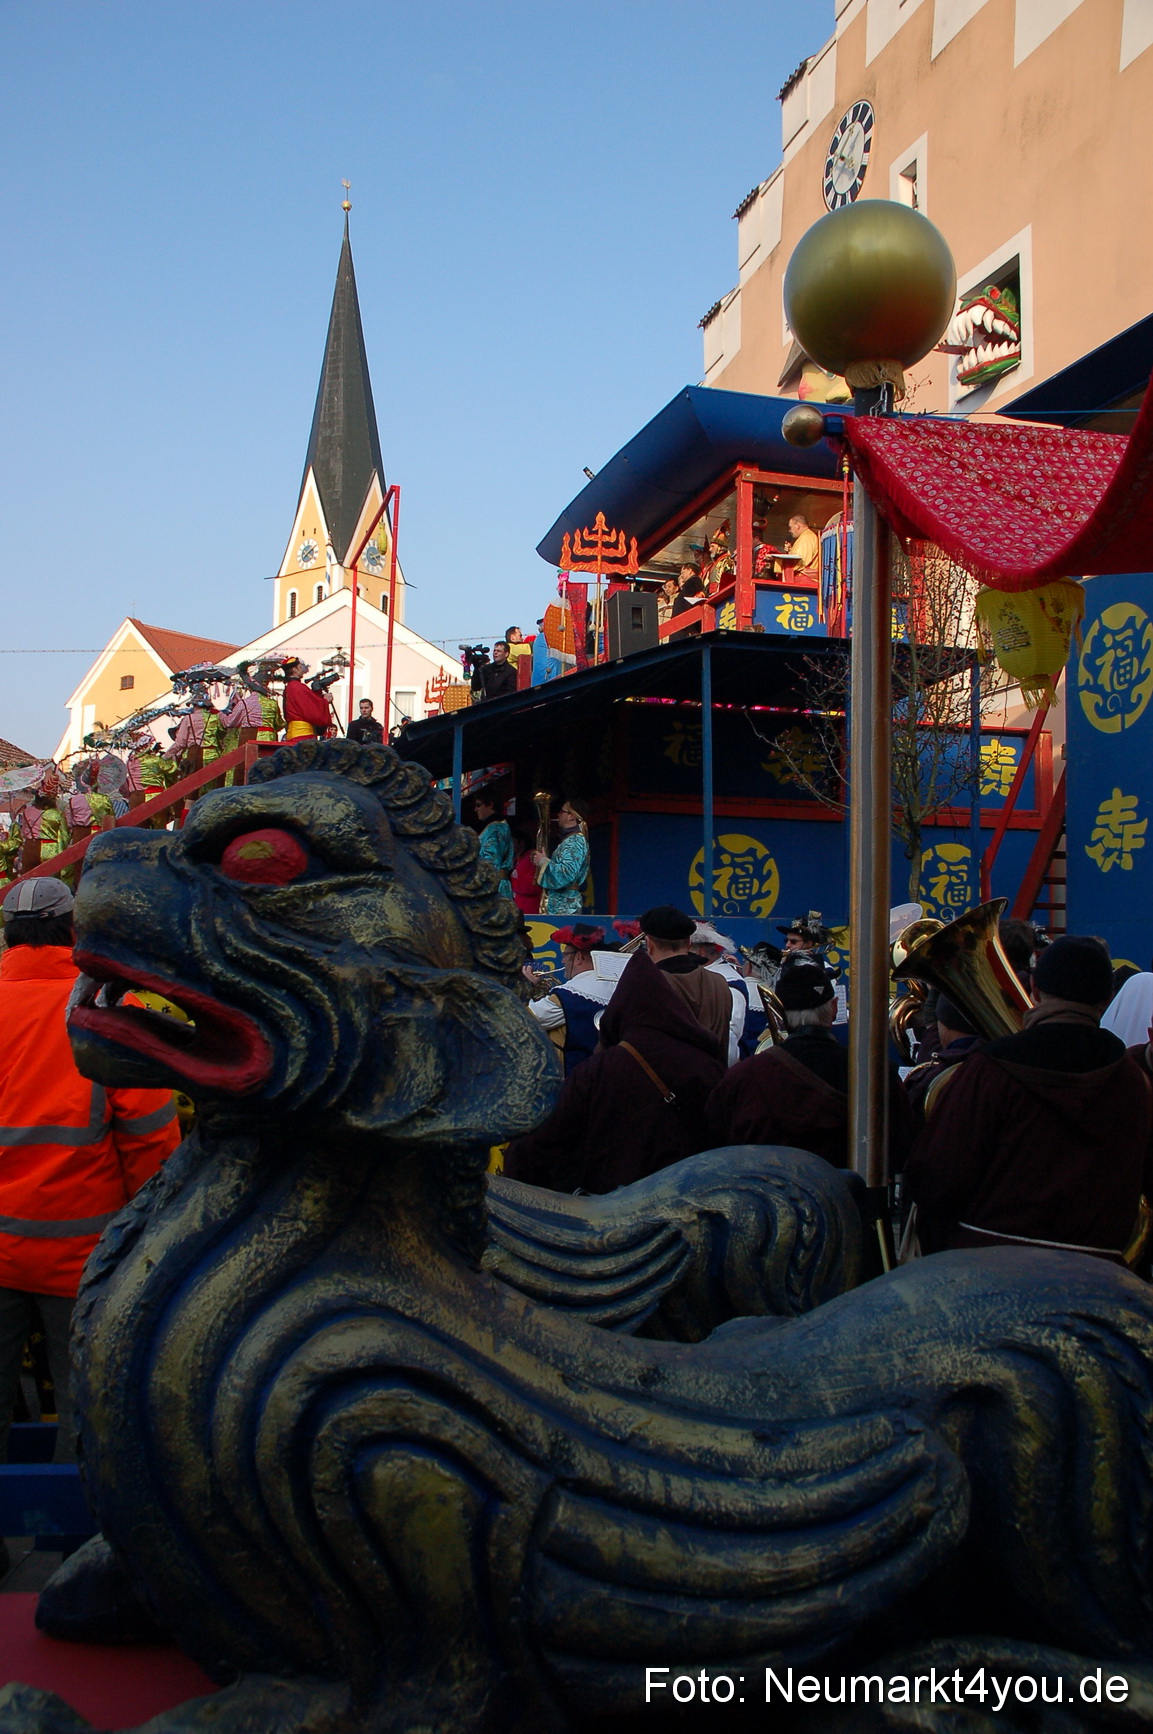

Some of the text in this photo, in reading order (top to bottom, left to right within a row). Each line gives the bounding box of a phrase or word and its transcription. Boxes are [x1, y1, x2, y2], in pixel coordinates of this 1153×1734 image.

[775, 593, 814, 631] 福
[1096, 628, 1138, 692] 福
[712, 853, 760, 900] 福
[929, 862, 971, 906] 福
